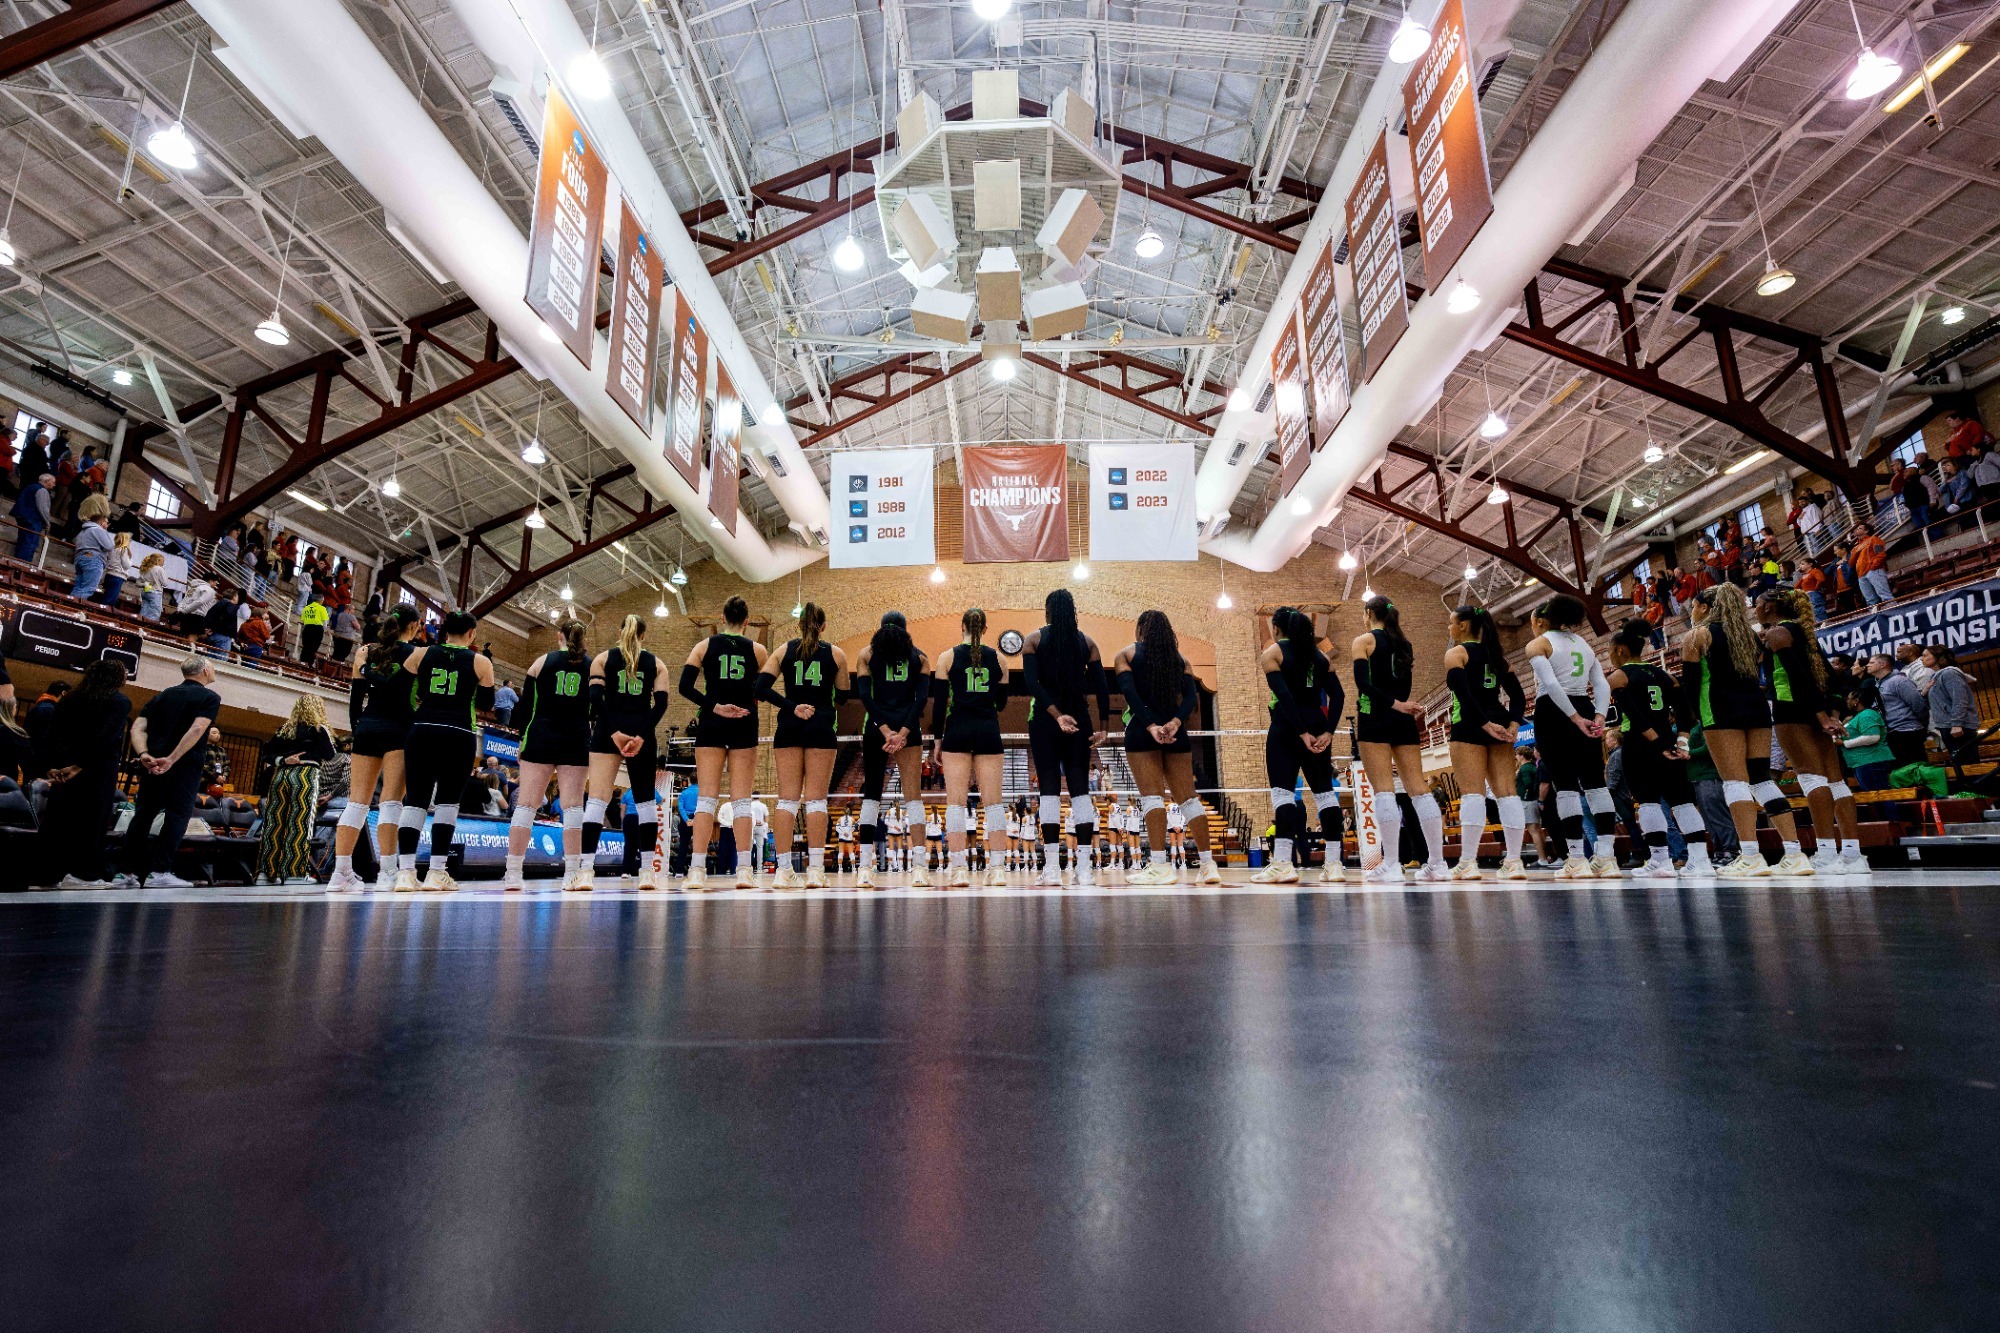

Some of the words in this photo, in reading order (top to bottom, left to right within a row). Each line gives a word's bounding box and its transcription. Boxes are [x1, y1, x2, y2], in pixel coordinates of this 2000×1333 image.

[1415, 20, 1450, 95] CONFERENCE
[1411, 25, 1460, 126] CHAMPIONS
[1445, 74, 1464, 114] 2023
[1420, 123, 1437, 158] 2019
[561, 150, 588, 209] FOUR
[1423, 150, 1441, 187] 2020
[563, 193, 581, 224] 1986
[1428, 180, 1444, 213] 2021
[561, 217, 579, 247] 1987
[1431, 208, 1449, 244] 2022
[556, 266, 574, 297] 1995
[630, 254, 650, 300] FOUR
[553, 290, 573, 321] 2008
[879, 477, 904, 488] 1981
[992, 475, 1039, 487] NATIONAL
[1136, 470, 1168, 482] 2022
[878, 502, 906, 513] 1988
[970, 486, 1062, 507] CHAMPIONS
[1137, 496, 1168, 508] 2023
[878, 527, 906, 539] 2012
[107, 634, 127, 648] USF
[1818, 622, 1882, 655] NCAA
[1888, 610, 1918, 638] DI
[35, 644, 60, 657] PERIOD
[719, 654, 745, 680] 15
[794, 660, 822, 687] 14
[885, 659, 909, 682] 13
[1570, 652, 1584, 677] 3
[430, 668, 458, 695] 21
[555, 671, 581, 697] 18
[618, 670, 644, 696] 16
[965, 666, 990, 692] 12
[1648, 685, 1664, 711] 3
[1357, 769, 1377, 845] TEXAS
